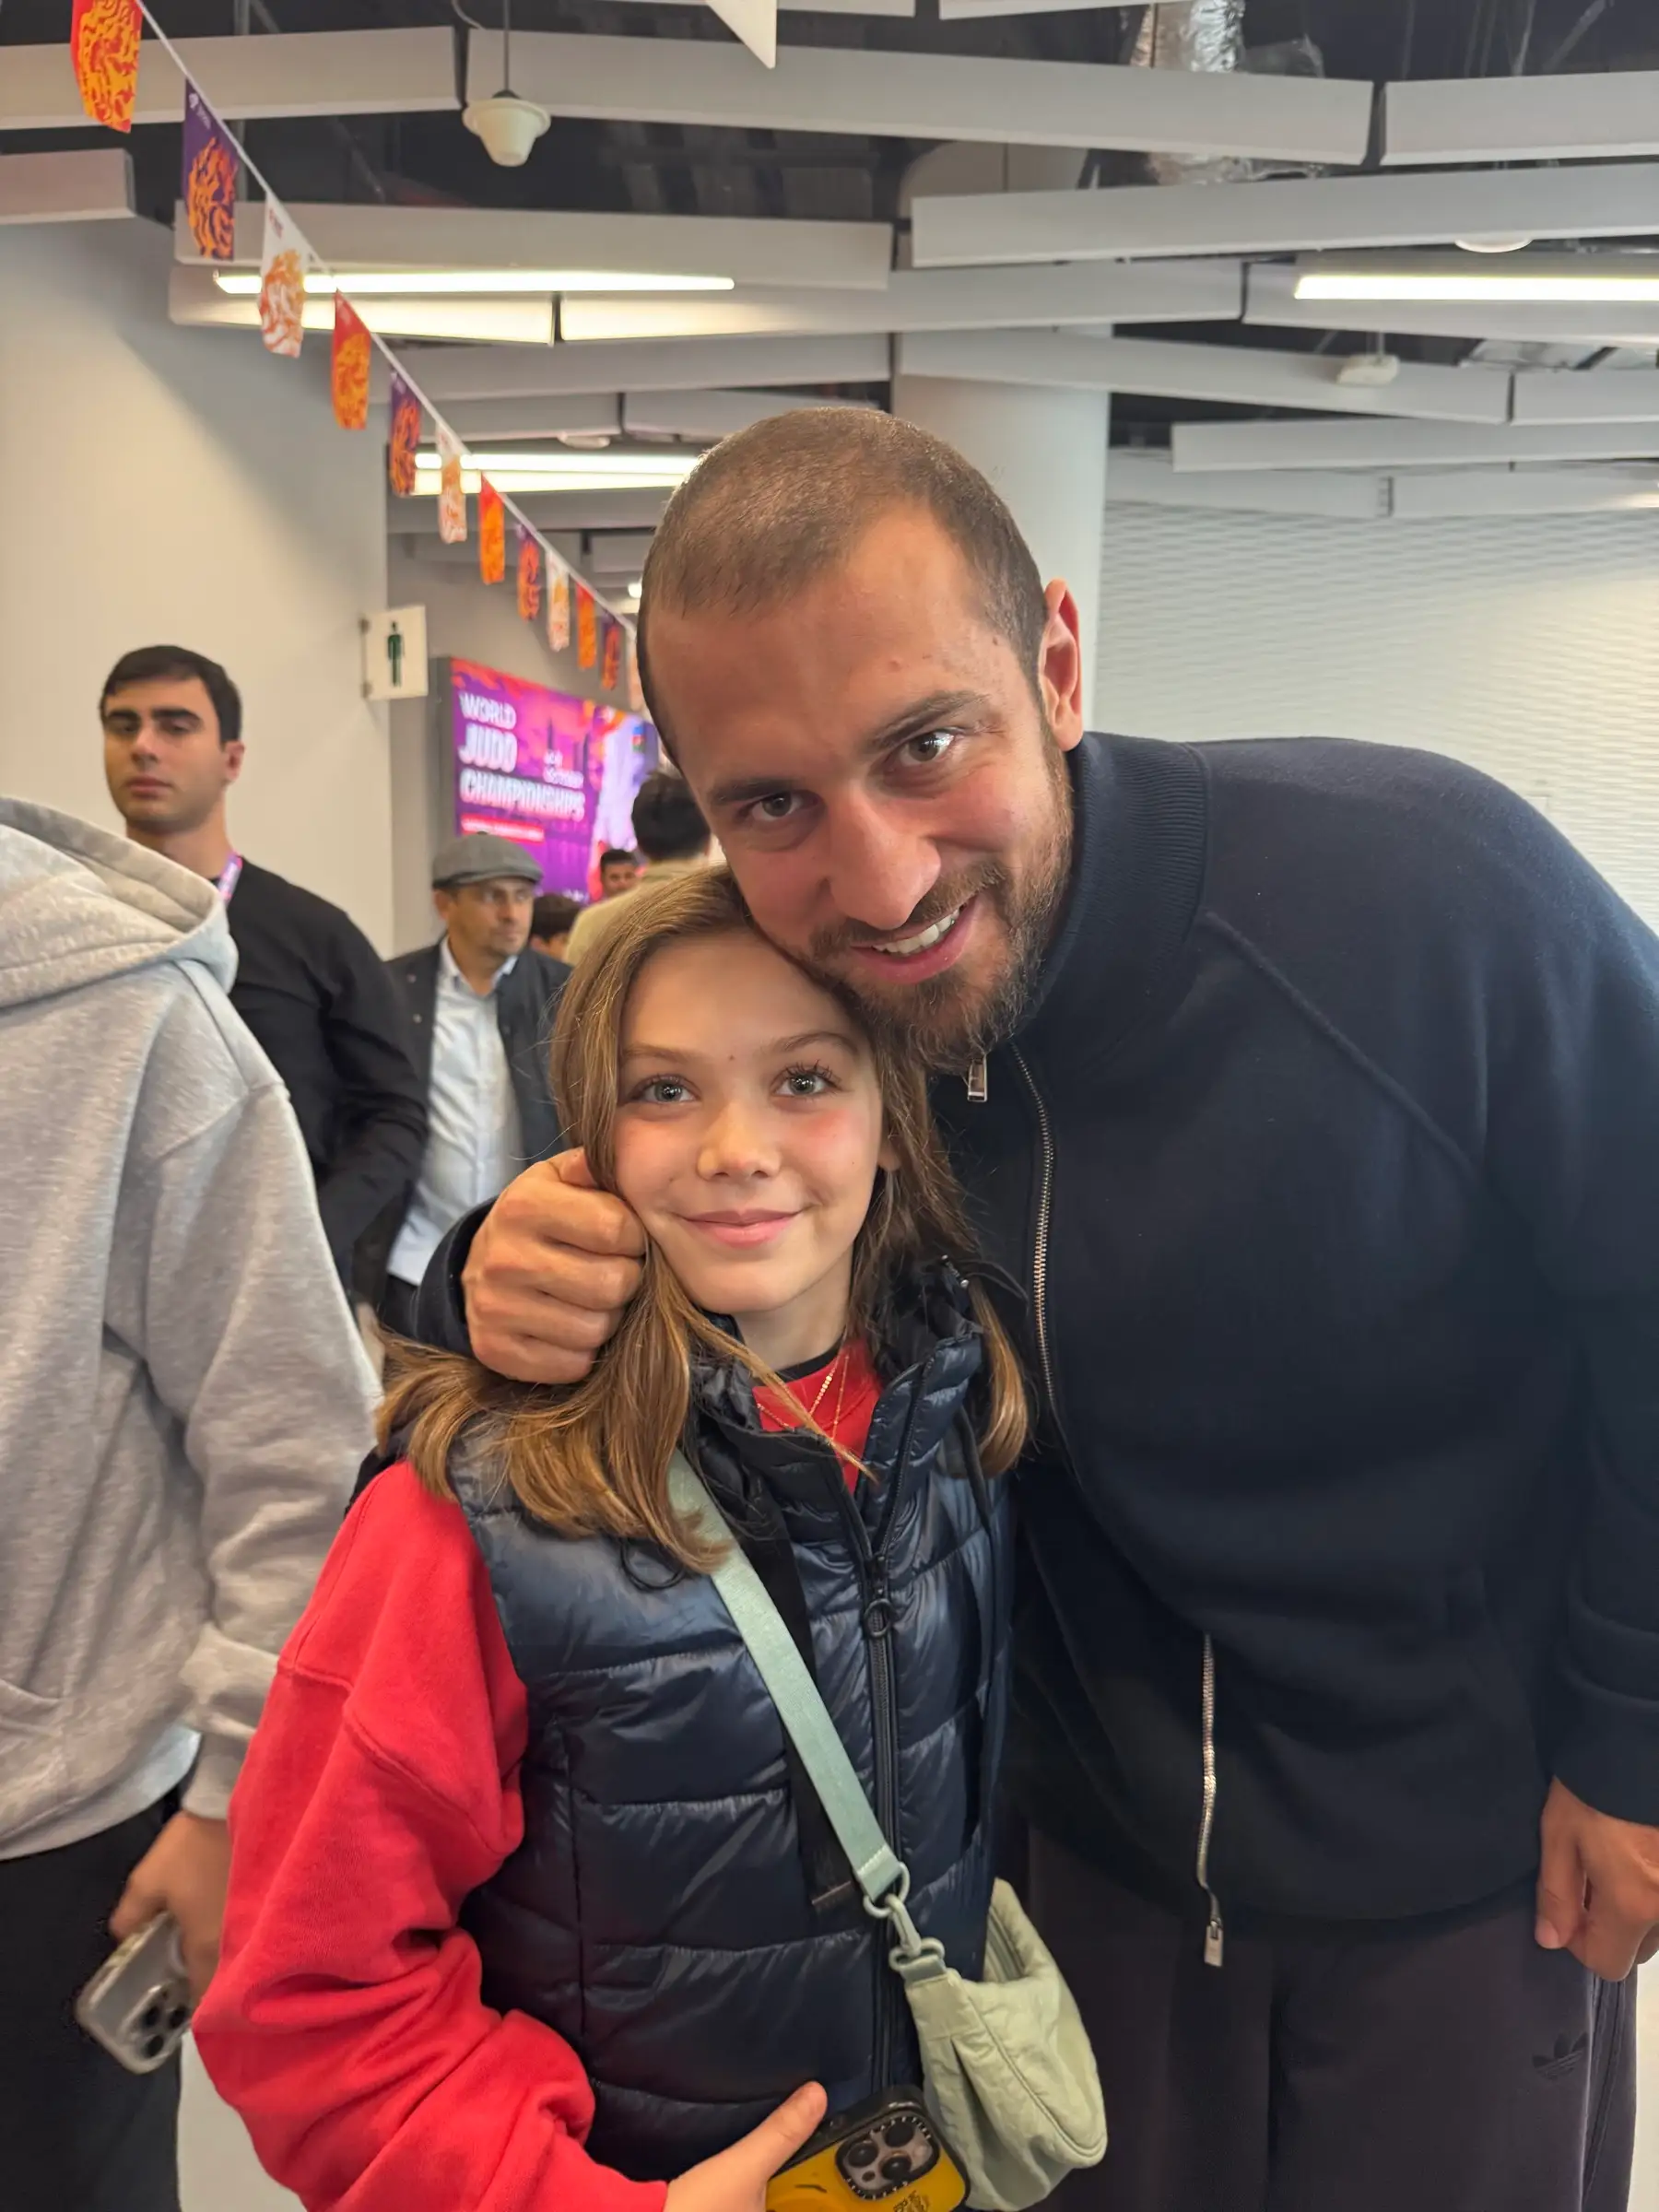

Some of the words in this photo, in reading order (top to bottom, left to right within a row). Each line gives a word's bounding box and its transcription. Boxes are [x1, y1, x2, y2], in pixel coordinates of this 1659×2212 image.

[459, 692, 516, 729] WORLD
[458, 723, 517, 772] JUDO
[460, 769, 585, 821] CHAMPIONSHIPS
